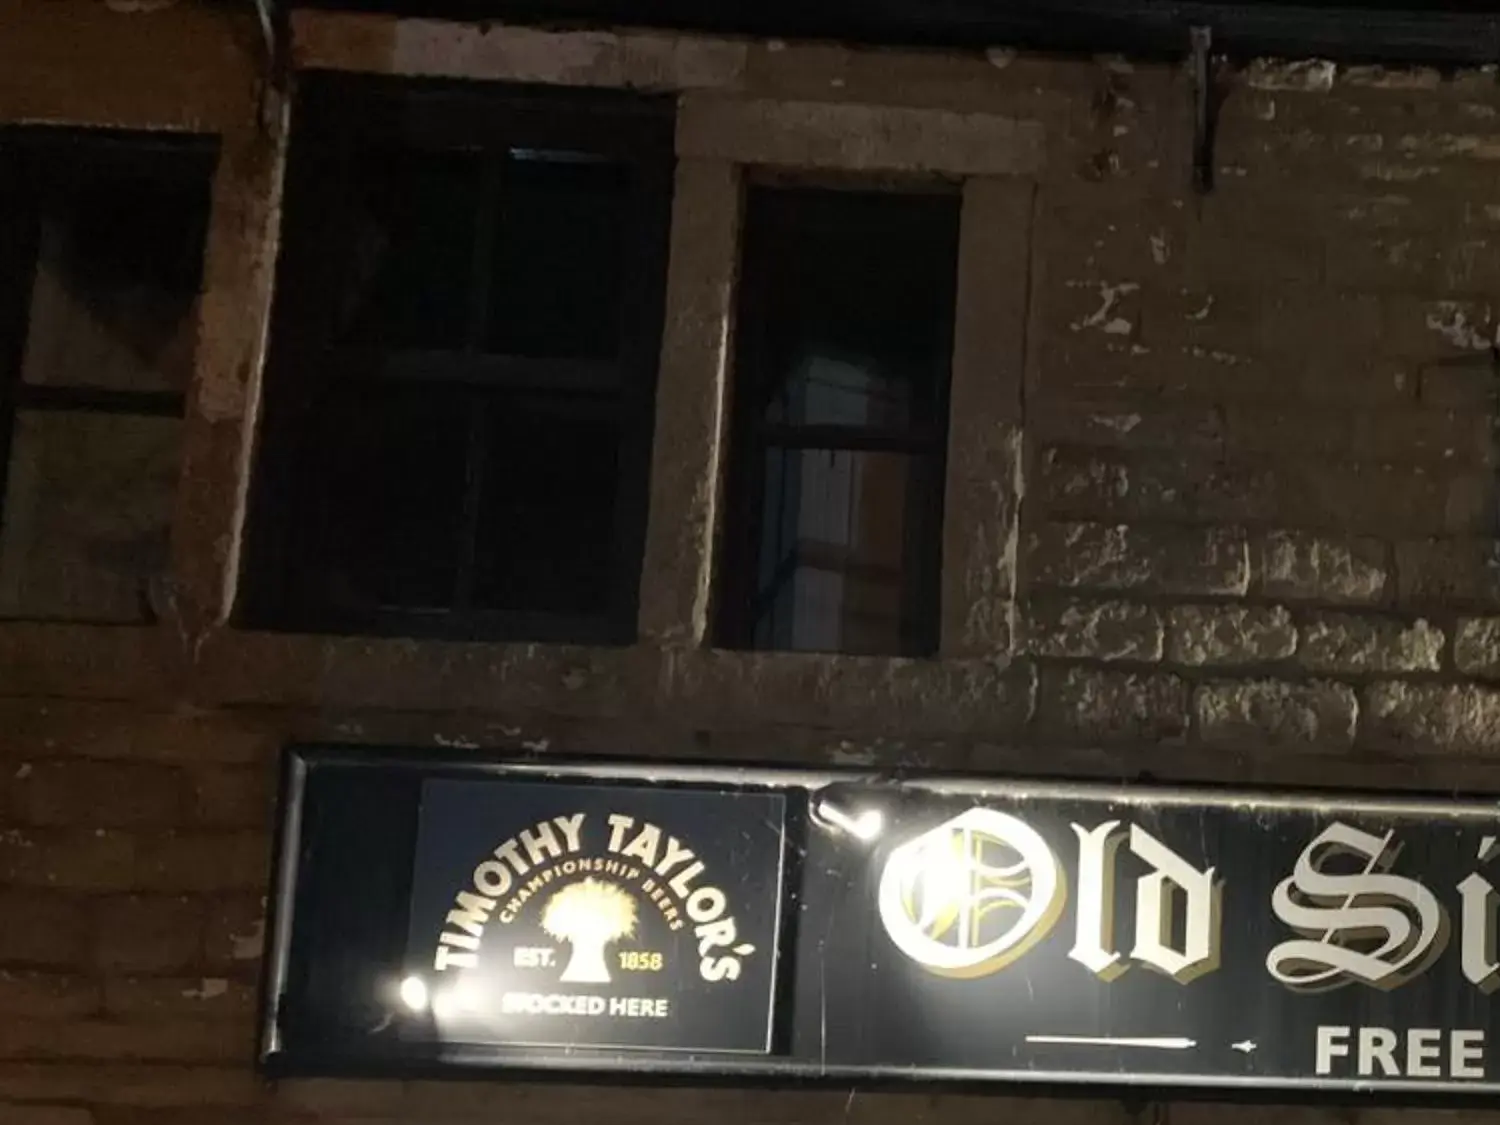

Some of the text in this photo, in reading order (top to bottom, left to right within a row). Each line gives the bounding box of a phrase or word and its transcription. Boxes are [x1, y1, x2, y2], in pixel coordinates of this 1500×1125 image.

[434, 813, 756, 983] TIMOTHY TAYLOR'S
[499, 857, 685, 932] CHAMPIONSHIP BEERS
[879, 806, 1224, 985] Old
[618, 952, 663, 972] 1858
[501, 991, 670, 1018] OCKED HERE
[1315, 1025, 1484, 1079] FREE
